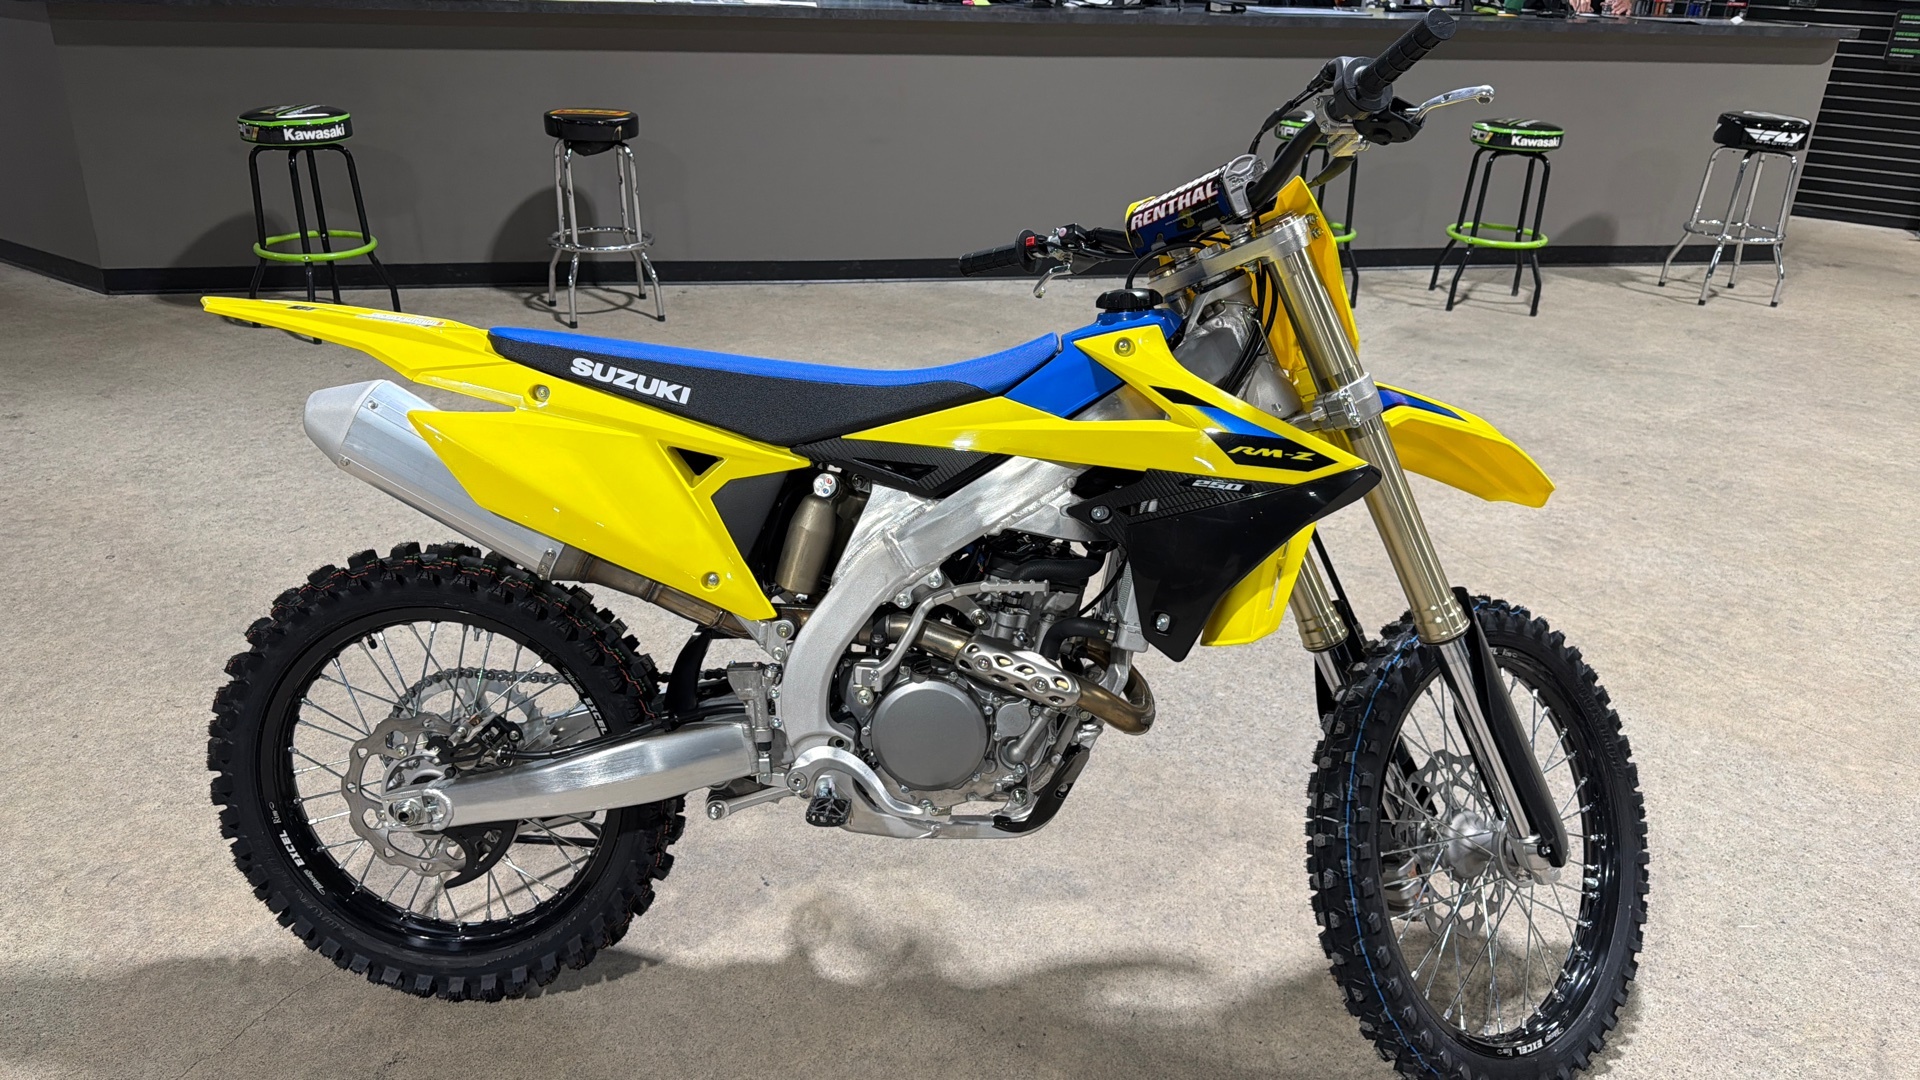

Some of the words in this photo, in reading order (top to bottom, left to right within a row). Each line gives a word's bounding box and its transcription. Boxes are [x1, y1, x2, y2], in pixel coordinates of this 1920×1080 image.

[283, 123, 345, 141] Kawasaki
[1748, 128, 1806, 144] FLY
[1510, 135, 1561, 147] Kawasaki
[1755, 139, 1794, 147] RACING
[1130, 181, 1219, 232] RENTHAL
[570, 357, 692, 405] SUZUKI
[1227, 446, 1316, 462] RM-Z
[1191, 479, 1245, 492] 250
[583, 697, 608, 735] EXCEL
[279, 829, 305, 867] EXCEL
[1516, 1038, 1544, 1055] EXCEL
